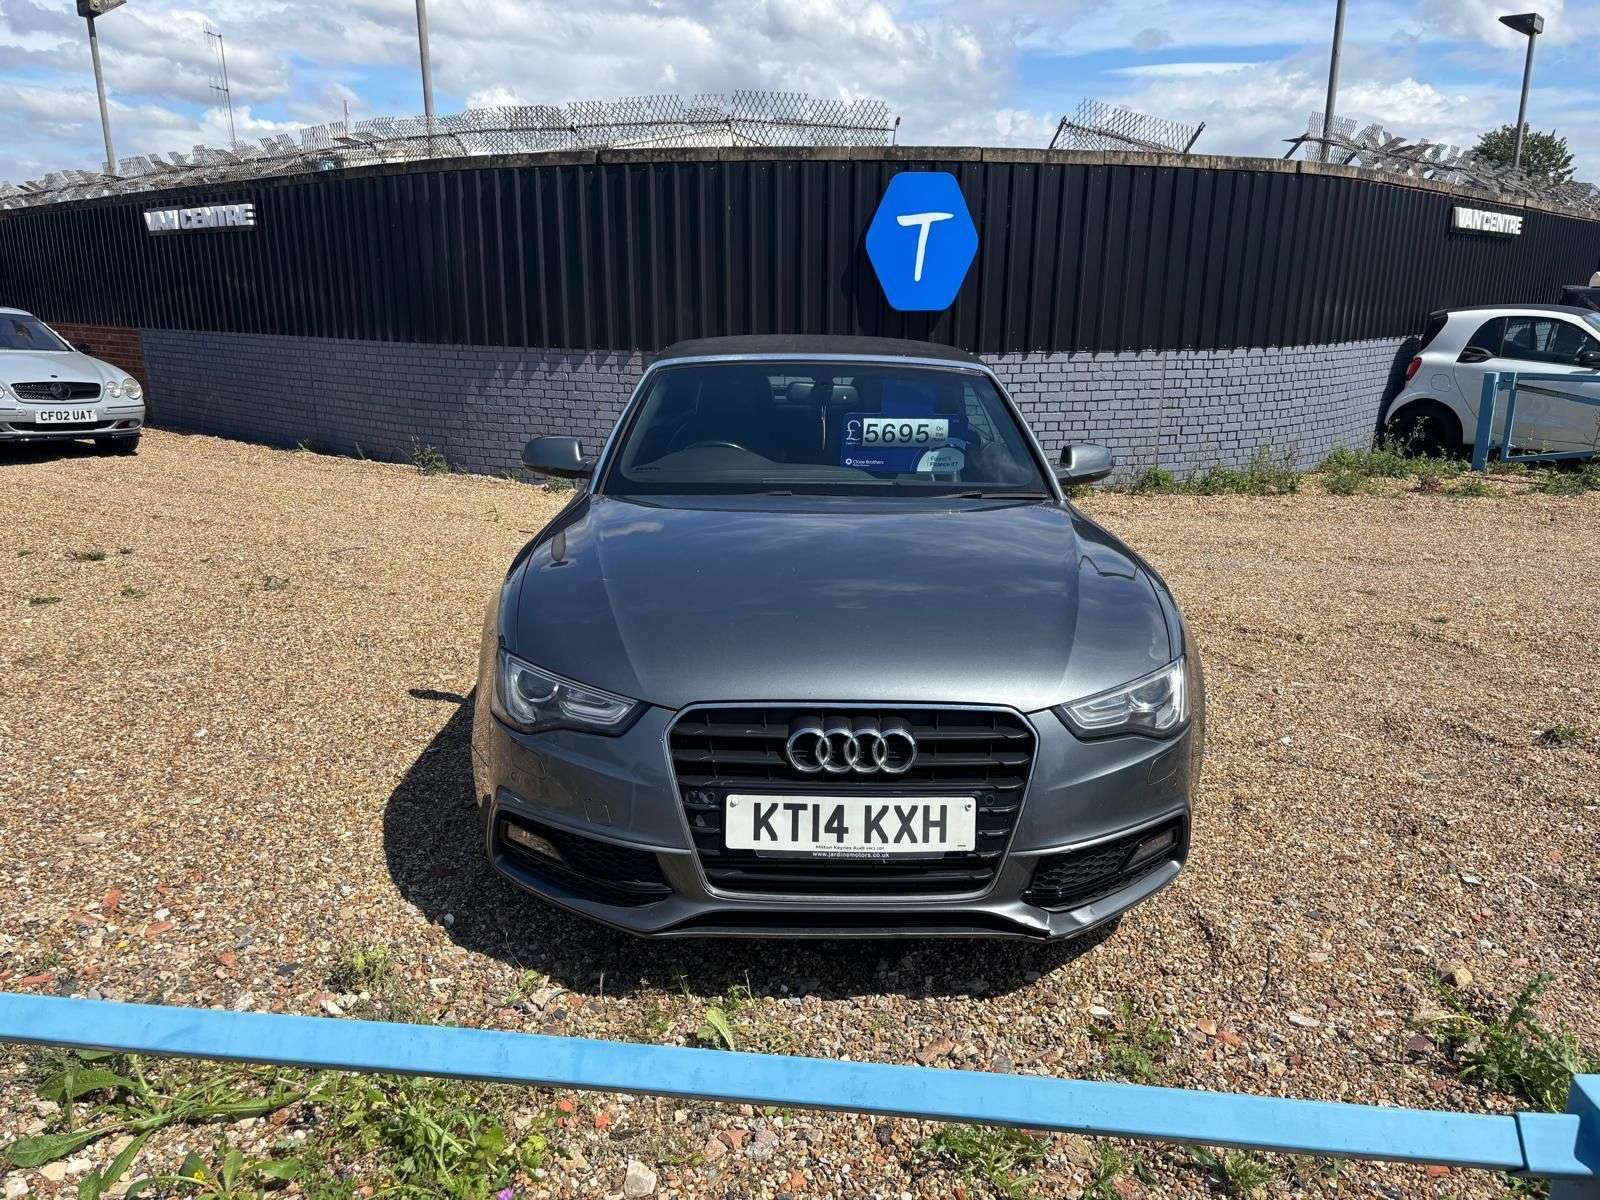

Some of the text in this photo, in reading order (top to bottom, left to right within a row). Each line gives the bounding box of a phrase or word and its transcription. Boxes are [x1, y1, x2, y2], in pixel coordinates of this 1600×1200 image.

[144, 203, 255, 231] VAN CENTRE
[1454, 206, 1523, 234] VAN CENTRE
[896, 211, 955, 282] T
[40, 410, 93, 421] CF02 UAT
[753, 802, 948, 844] KT14 KXH
